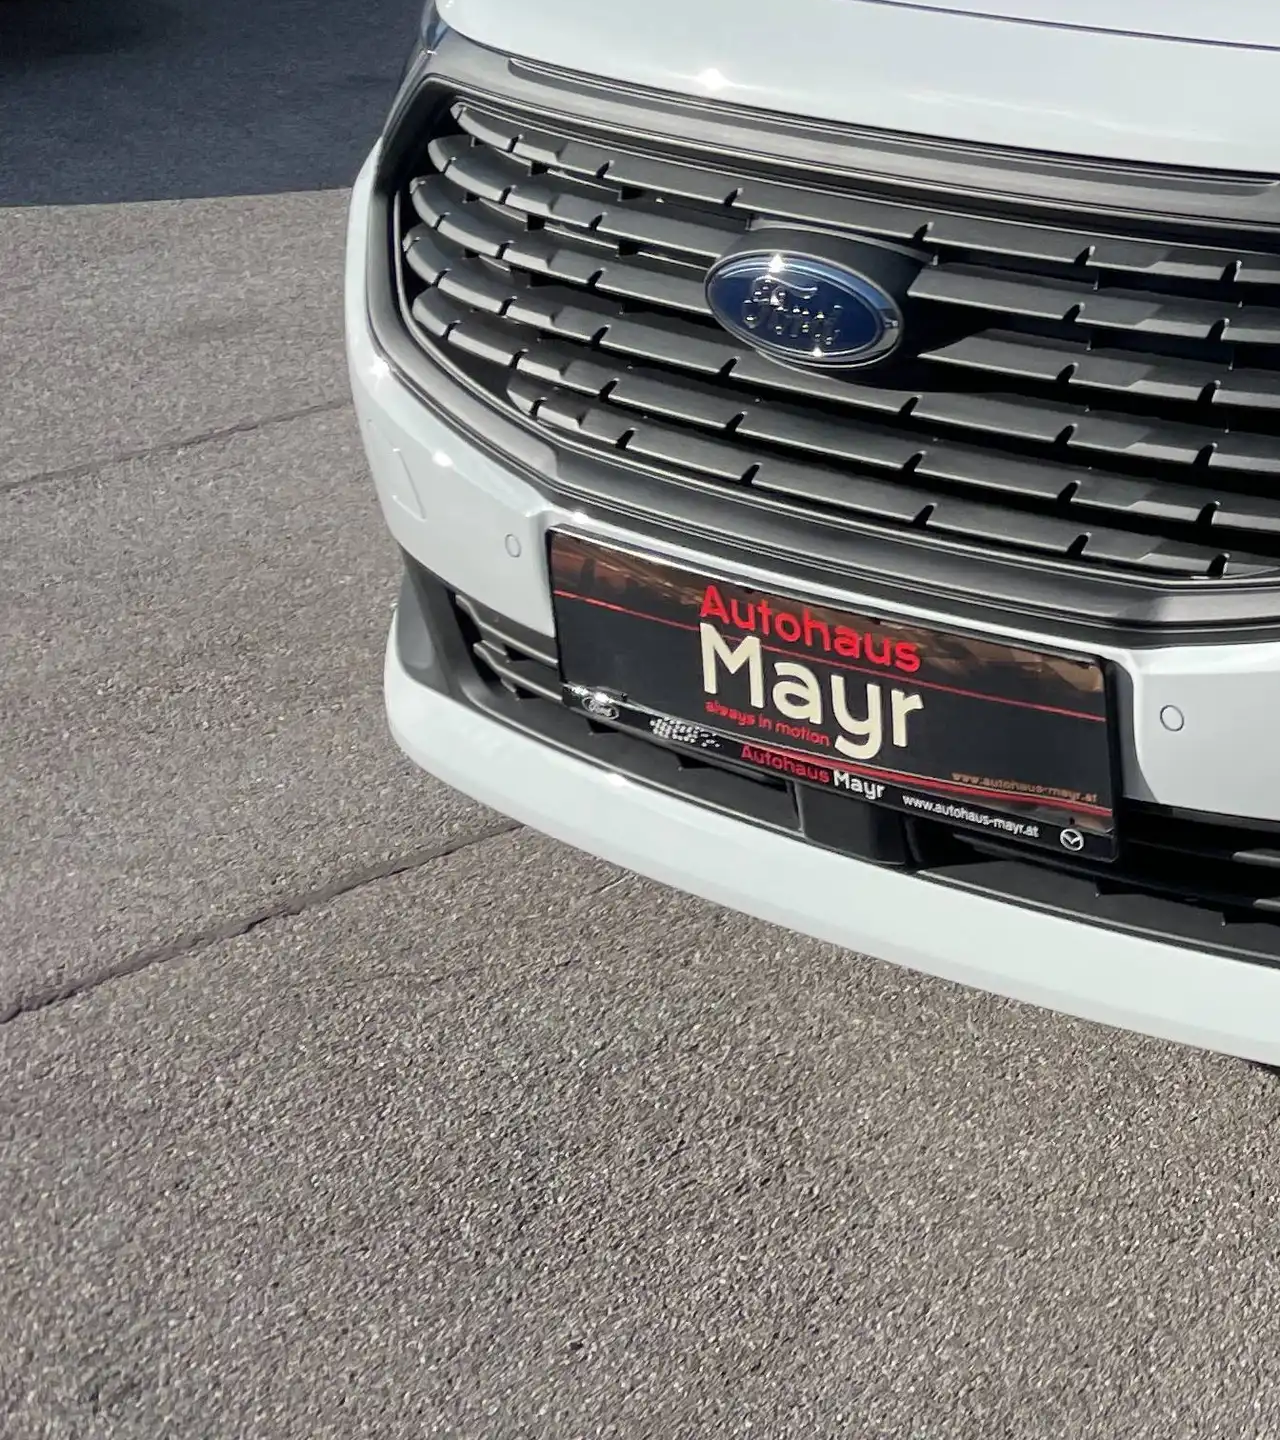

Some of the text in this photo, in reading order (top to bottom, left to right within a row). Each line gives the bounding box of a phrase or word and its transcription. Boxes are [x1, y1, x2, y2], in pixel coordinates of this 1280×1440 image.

[700, 584, 921, 673] Autohaus
[700, 622, 924, 760] Mayr
[704, 699, 830, 747] always in motion
[740, 743, 885, 800] Autohaus Mayr
[951, 771, 1098, 803] www.autohaus-mayr.at
[902, 795, 1040, 838] www.autohaus-mayr.at
